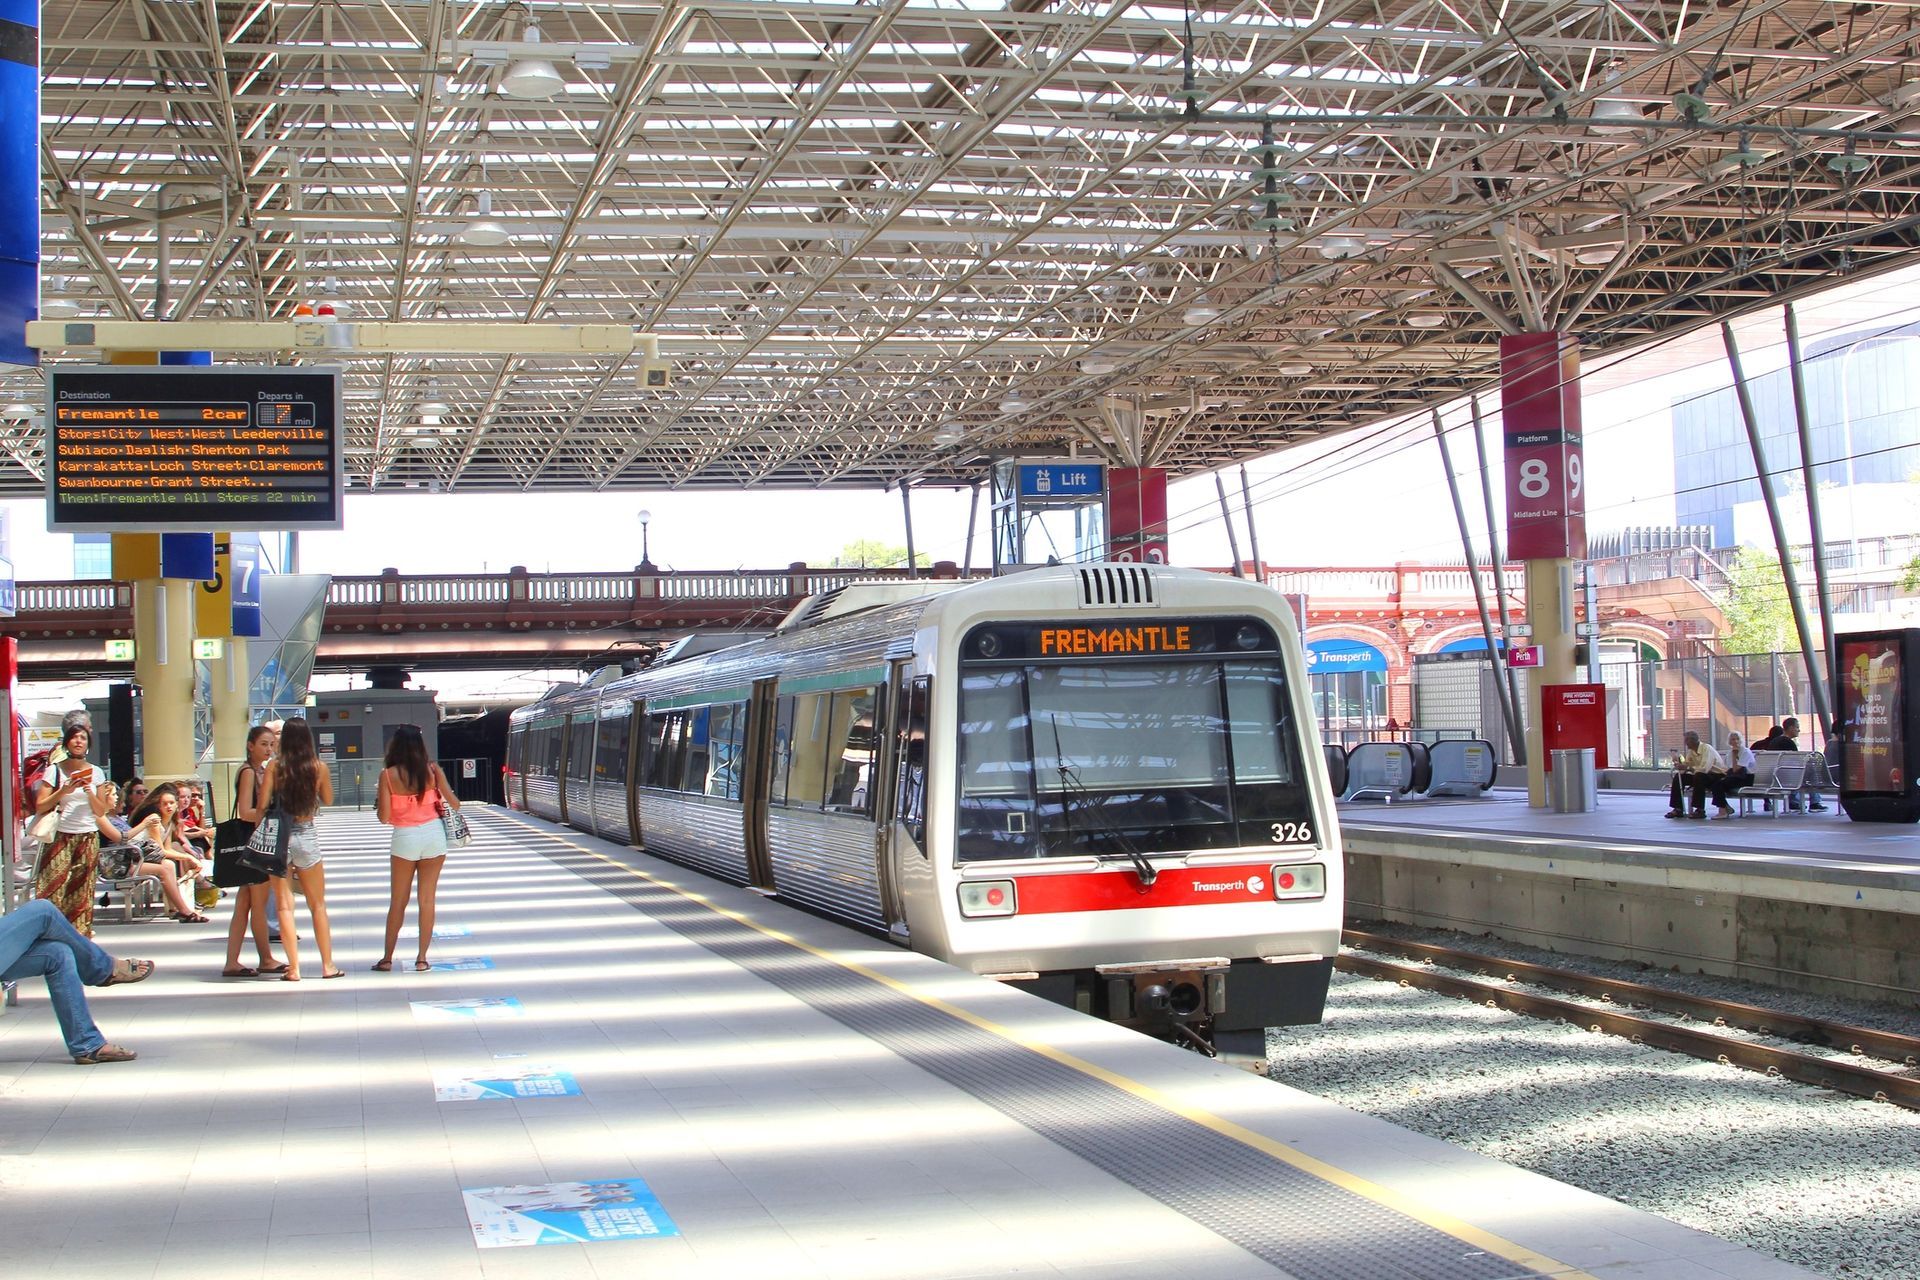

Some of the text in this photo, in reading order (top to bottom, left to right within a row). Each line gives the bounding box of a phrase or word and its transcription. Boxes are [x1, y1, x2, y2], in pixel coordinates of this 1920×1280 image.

[59, 390, 111, 400] Destination
[257, 391, 303, 401] Departs in
[58, 408, 246, 419] Fremantle 2car
[275, 404, 291, 424] 7
[232, 428, 324, 439] Leederville
[1517, 434, 1549, 443] Platform
[257, 444, 290, 455] Park
[1061, 473, 1087, 486] Lift
[1519, 458, 1550, 498] 8
[1568, 453, 1582, 499] 9
[184, 492, 208, 503] All
[216, 492, 258, 503] Stops
[266, 492, 283, 503] 22
[291, 492, 316, 503] min
[1513, 509, 1558, 519] Midland Line
[236, 560, 255, 594] 7
[1041, 626, 1190, 655] FREMANTLE
[1320, 651, 1371, 663] Transperth
[1515, 651, 1531, 661] Perth
[1860, 715, 1888, 724] winners
[1860, 745, 1888, 756] Monday
[1271, 821, 1312, 842] 326
[1192, 880, 1244, 892] Transperth
